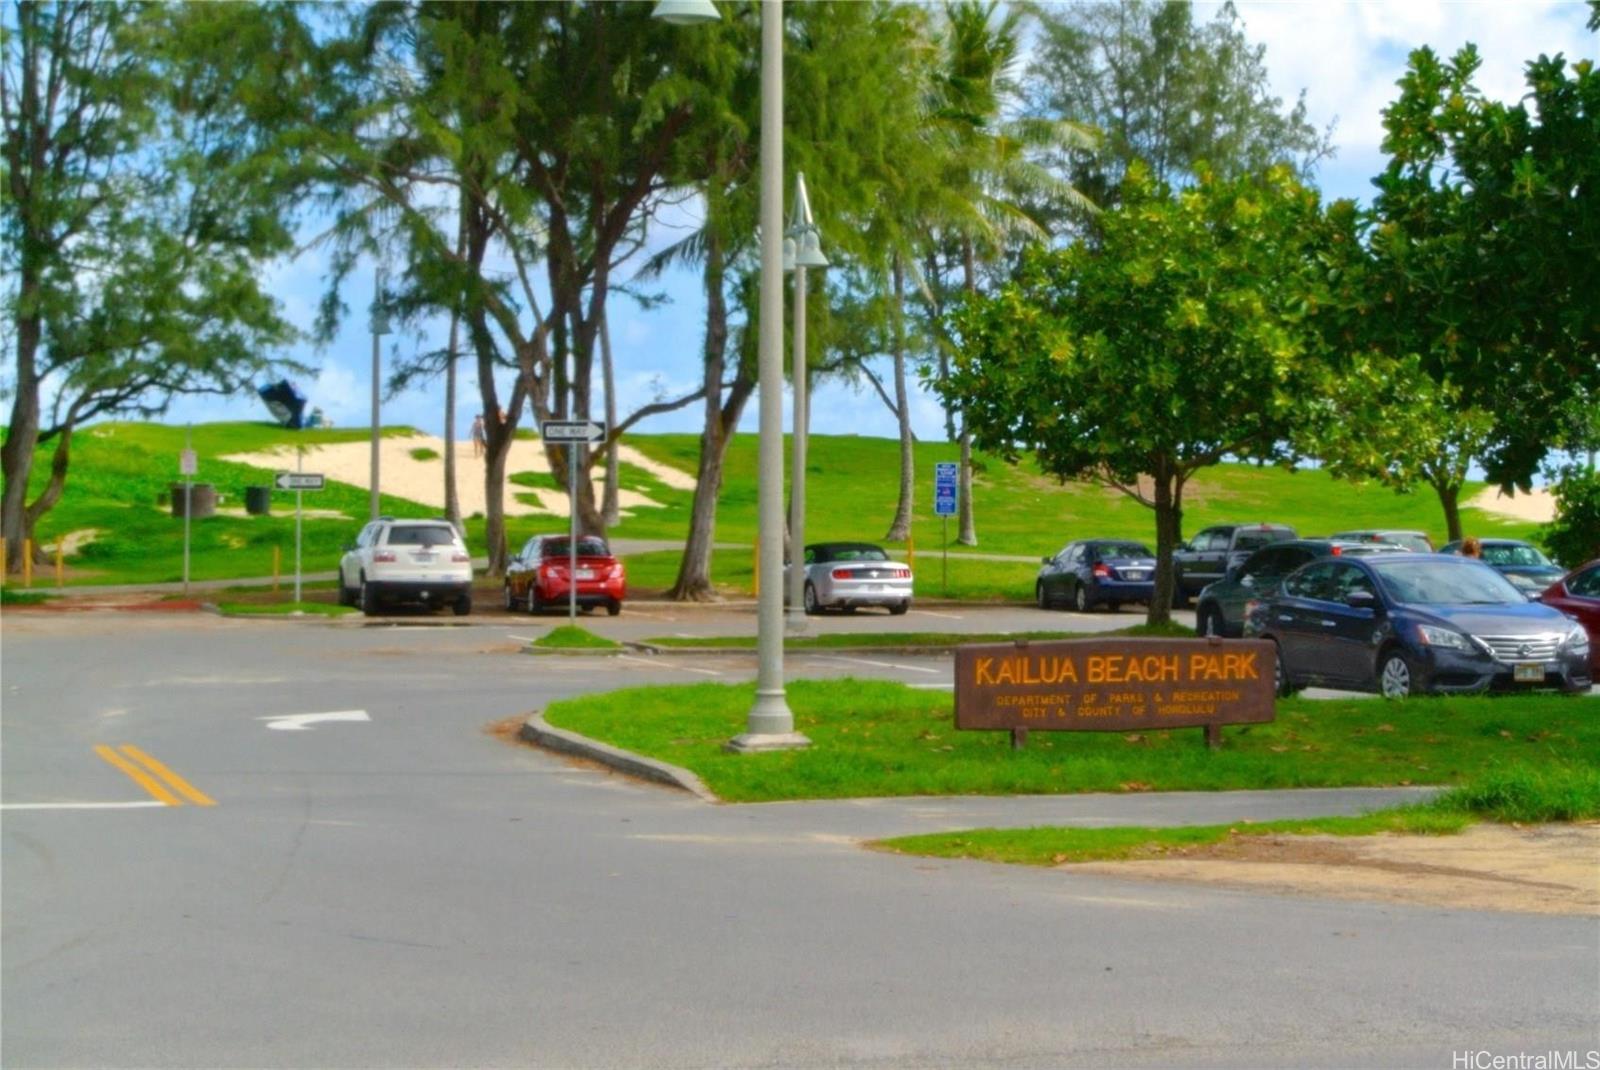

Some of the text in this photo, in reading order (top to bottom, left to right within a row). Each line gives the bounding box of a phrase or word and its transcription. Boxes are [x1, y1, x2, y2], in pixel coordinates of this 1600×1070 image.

[975, 652, 1258, 685] KAILUA BEACH PARK
[996, 693, 1071, 707] DEPARTMENT
[1083, 693, 1097, 705] OF
[1022, 706, 1048, 718] CITY
[1078, 705, 1122, 717] COUNTY
[1132, 705, 1146, 716] OF
[1158, 704, 1216, 716] HONOLULU
